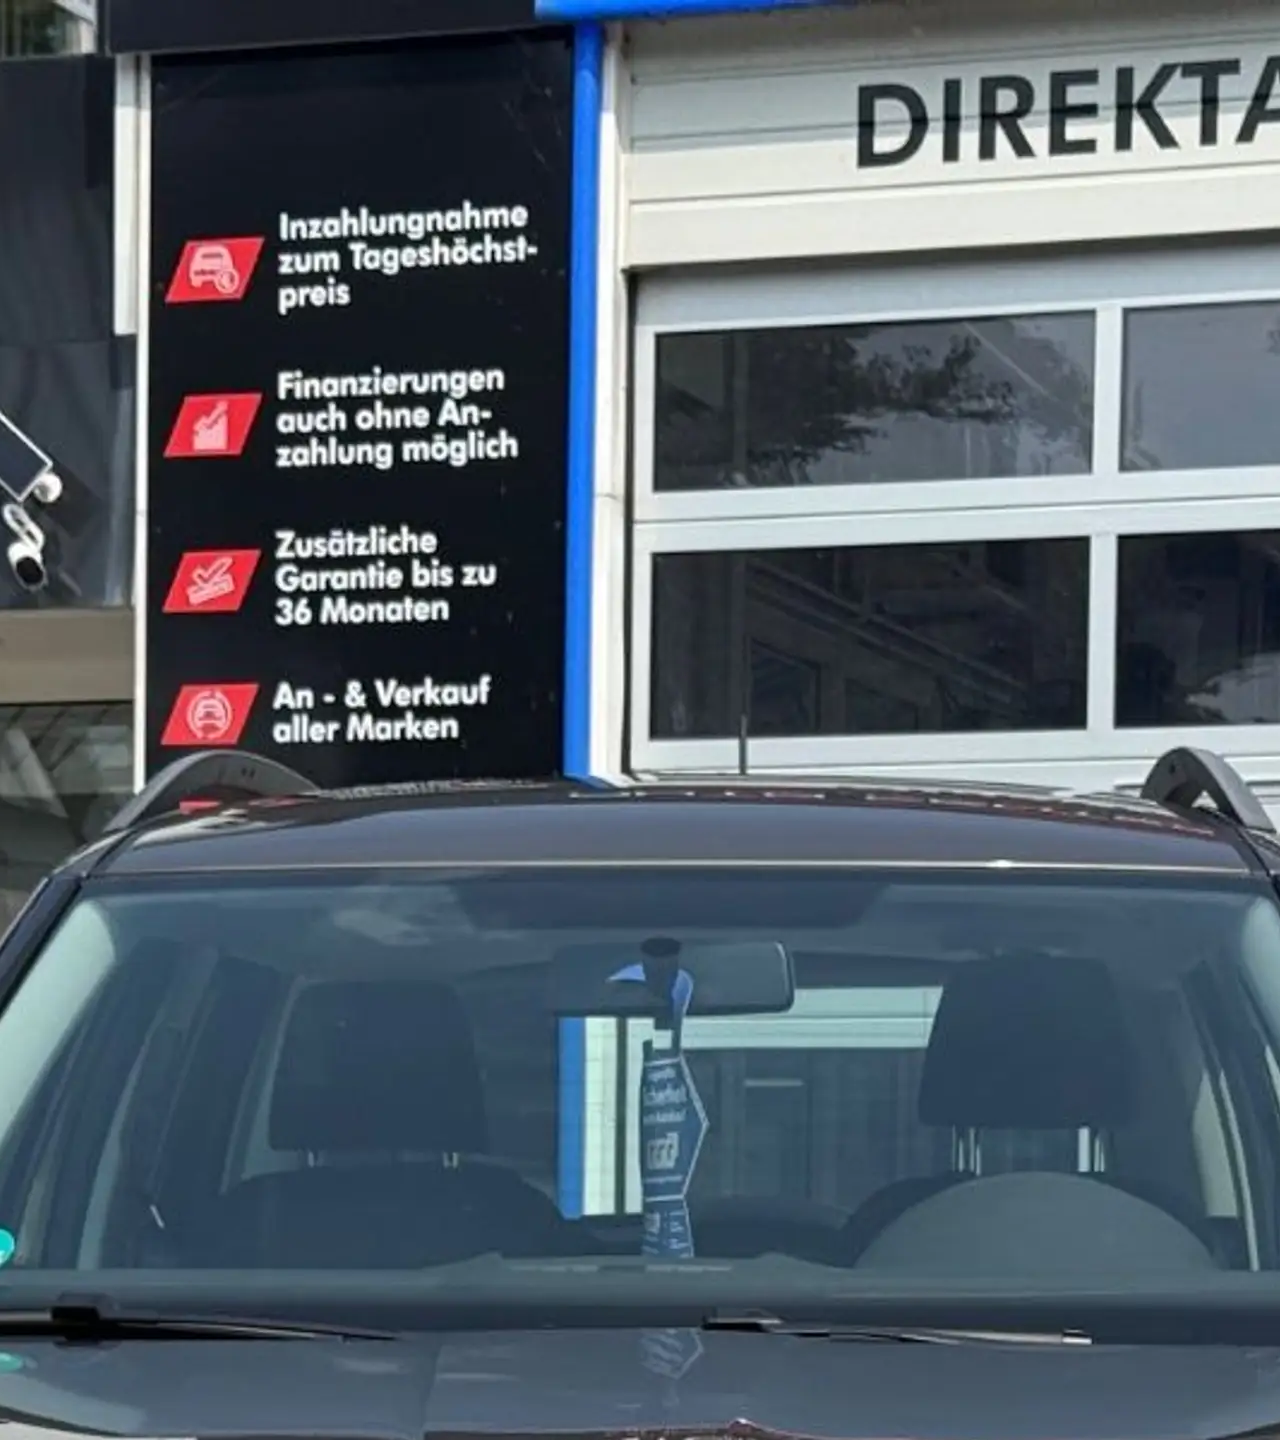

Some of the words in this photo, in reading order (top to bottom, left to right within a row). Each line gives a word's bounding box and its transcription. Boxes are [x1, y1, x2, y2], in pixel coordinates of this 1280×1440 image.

[279, 200, 529, 240] Inzahlungnahme
[278, 251, 340, 274] zum
[348, 236, 538, 276] Tageshöchst-
[278, 276, 351, 316] preis
[277, 366, 505, 402] Finanzierungen
[276, 402, 347, 434] auch
[355, 401, 430, 428] ohne
[437, 400, 492, 426] An-
[276, 436, 393, 470] zahlung
[402, 428, 519, 467] möglich
[275, 525, 438, 559] Zusätzliche
[275, 559, 404, 593] Garantie
[411, 558, 454, 588] bis
[461, 565, 497, 586] zu
[275, 597, 313, 626] 36
[320, 595, 449, 624] Monaten
[344, 680, 367, 708] &
[374, 674, 491, 707] Verkauf
[272, 713, 341, 744] aller
[346, 710, 459, 741] Marken
